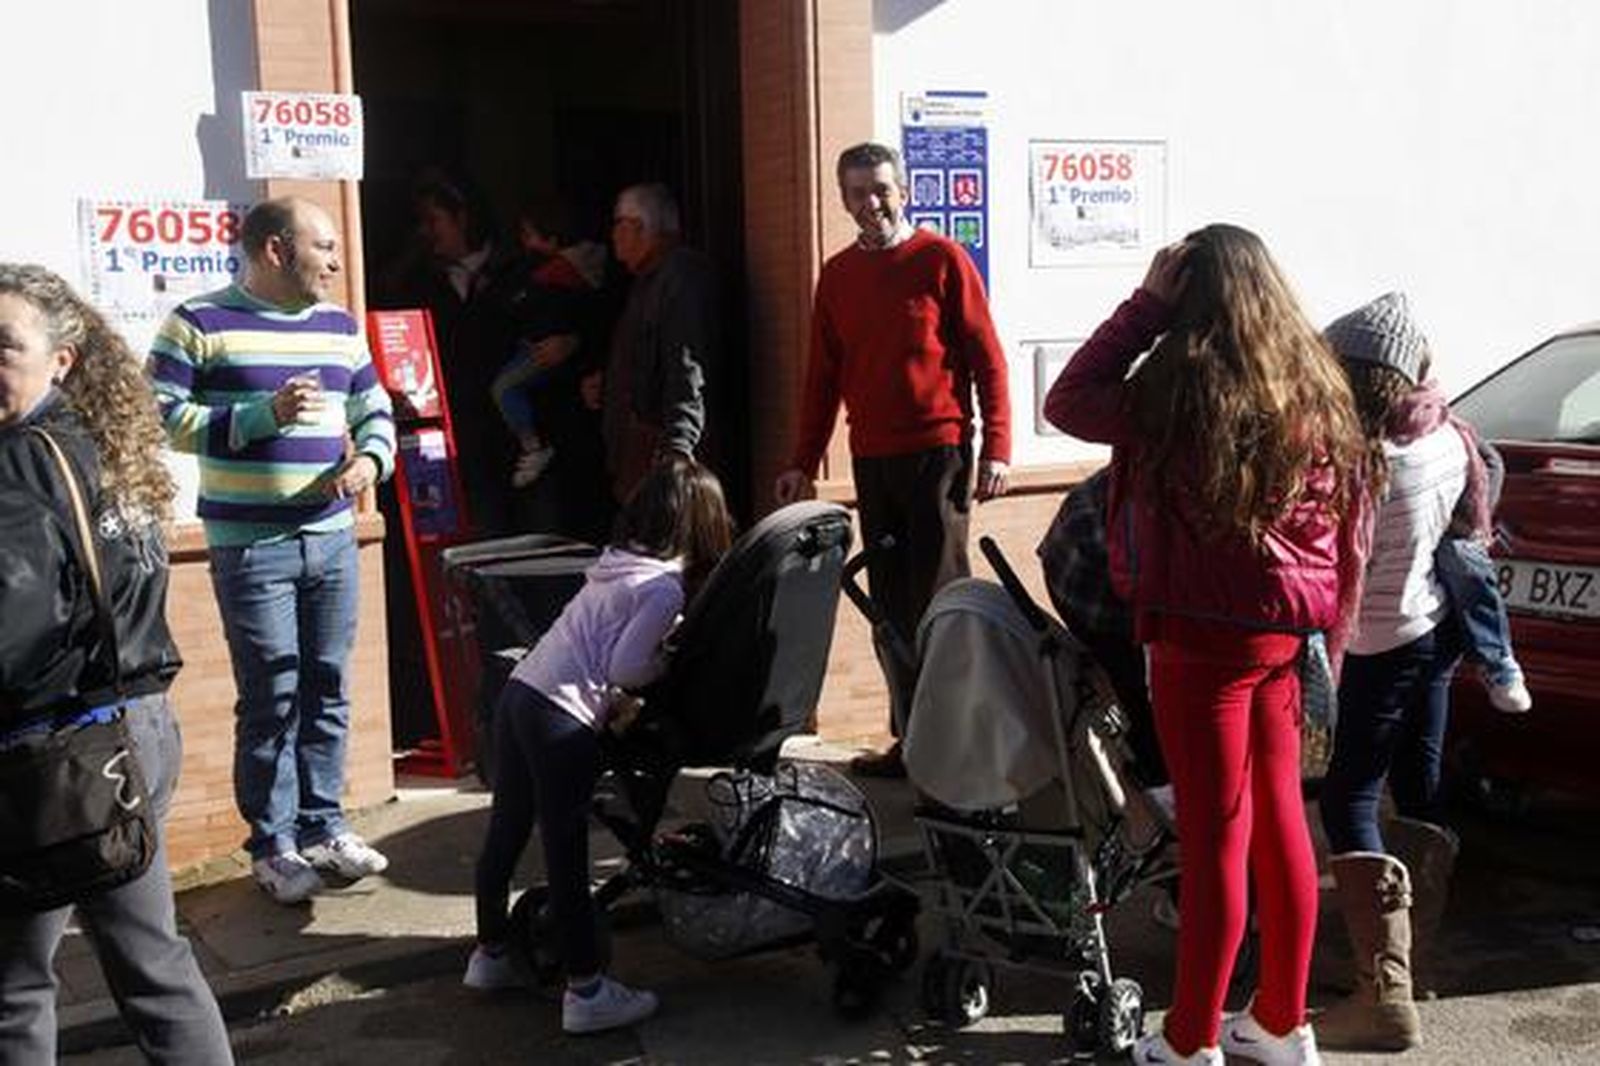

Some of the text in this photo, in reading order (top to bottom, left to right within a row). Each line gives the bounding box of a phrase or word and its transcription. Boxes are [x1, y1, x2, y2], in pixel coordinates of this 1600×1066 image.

[255, 99, 351, 126] 76058
[285, 128, 350, 146] Premio
[1043, 153, 1132, 181] 76058
[1070, 186, 1132, 204] Premio
[97, 208, 240, 245] 76058
[141, 250, 240, 273] Premio
[1529, 567, 1594, 610] BXZ
